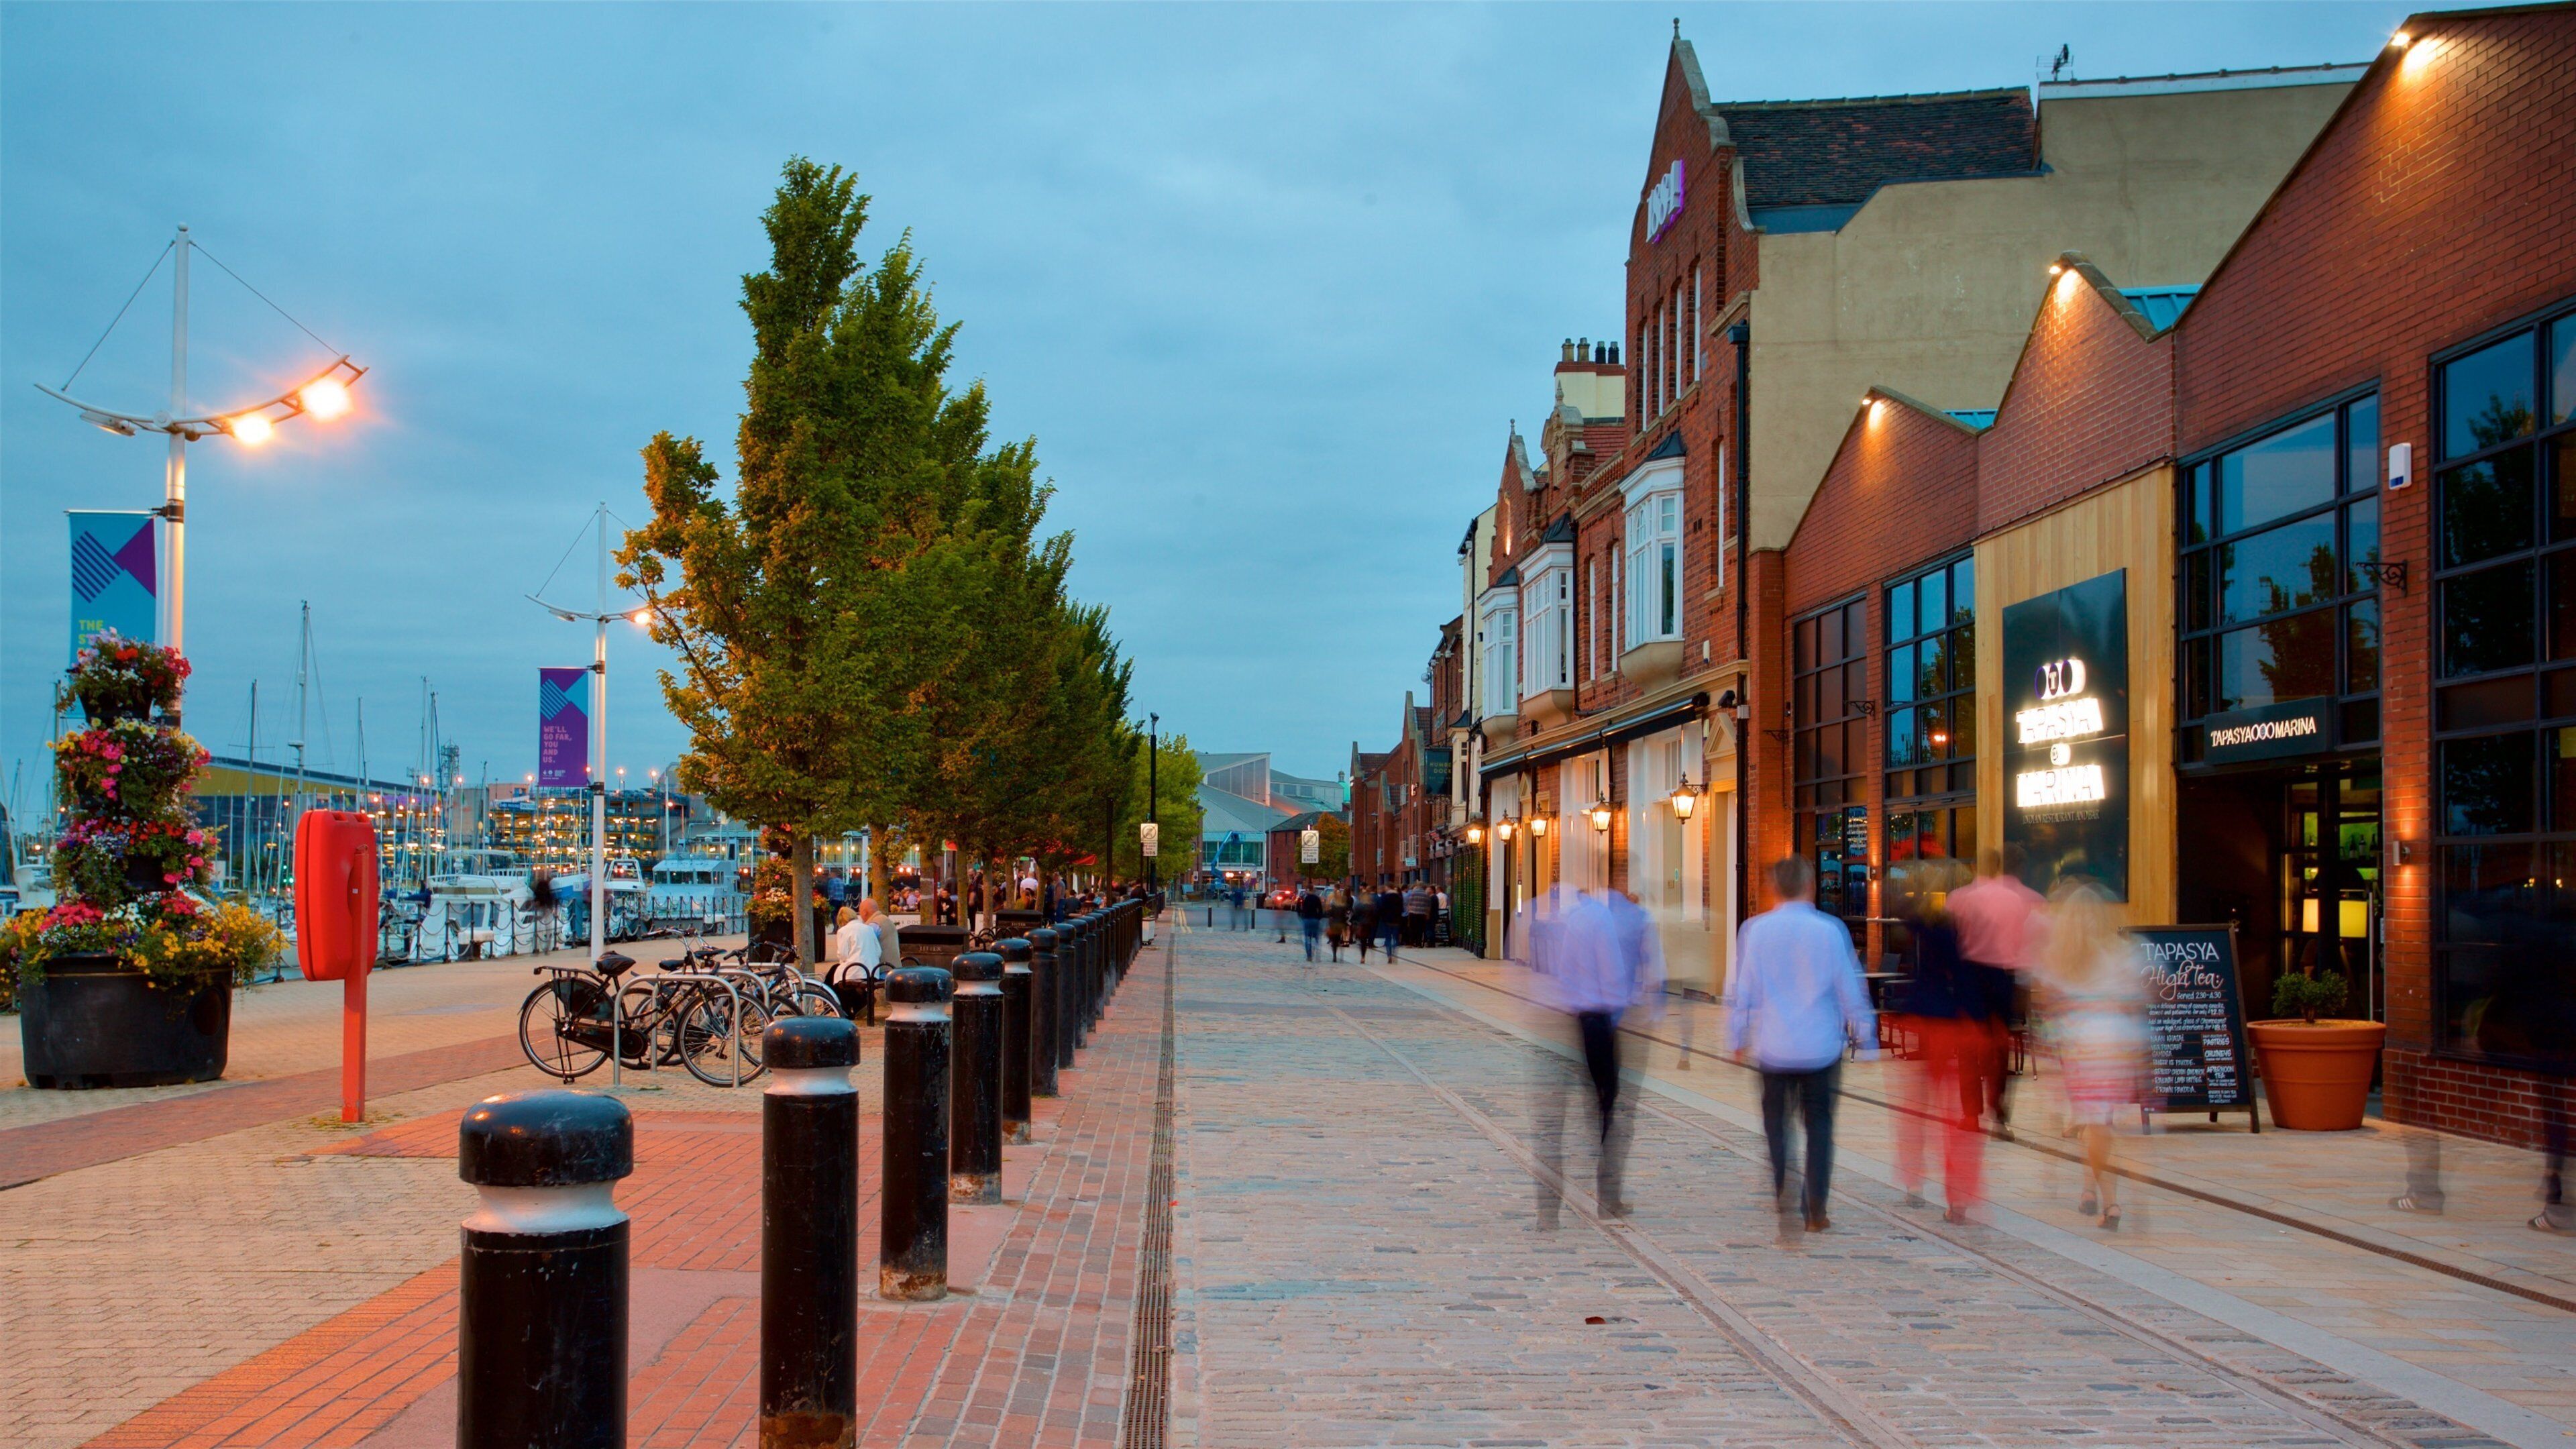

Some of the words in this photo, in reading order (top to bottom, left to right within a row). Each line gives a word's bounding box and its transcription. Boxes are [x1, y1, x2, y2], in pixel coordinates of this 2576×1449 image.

[78, 619, 103, 631] THE
[2016, 697, 2104, 744] TAPASYA
[555, 733, 572, 741] FAR,
[2017, 764, 2105, 808] MARINA
[2141, 942, 2220, 961] TAPASYA
[2141, 959, 2194, 1000] High
